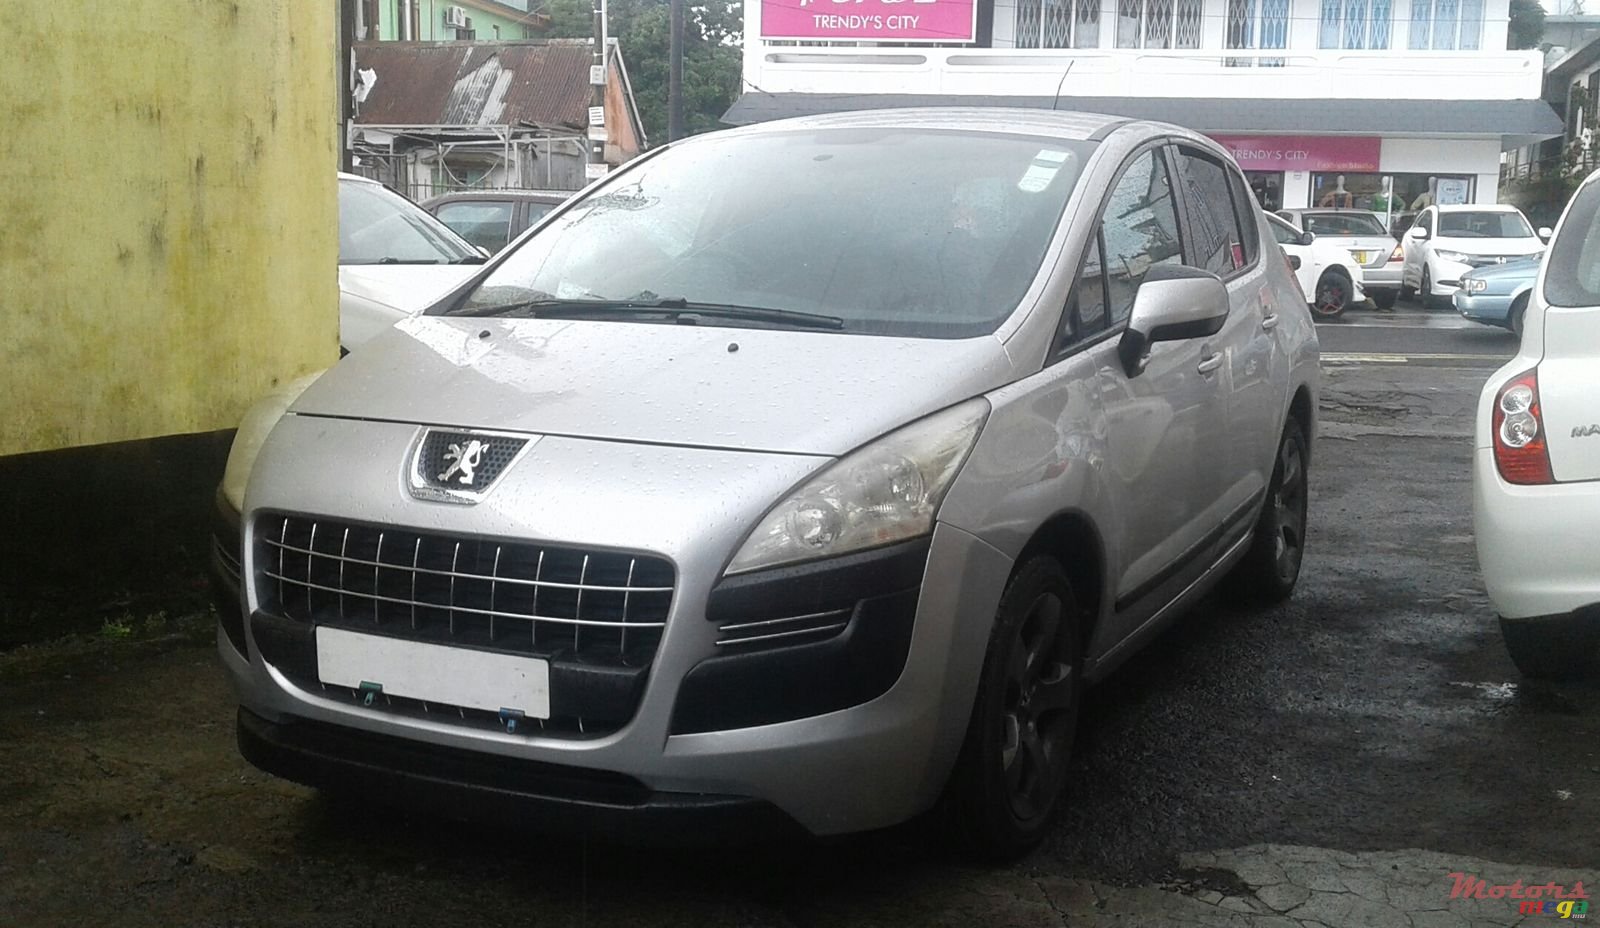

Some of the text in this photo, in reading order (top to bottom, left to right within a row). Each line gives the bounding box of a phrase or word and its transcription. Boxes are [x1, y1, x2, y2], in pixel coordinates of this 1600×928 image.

[813, 15, 919, 29] TRENDY'S CITY
[1231, 149, 1309, 160] TRENDY'S CITY
